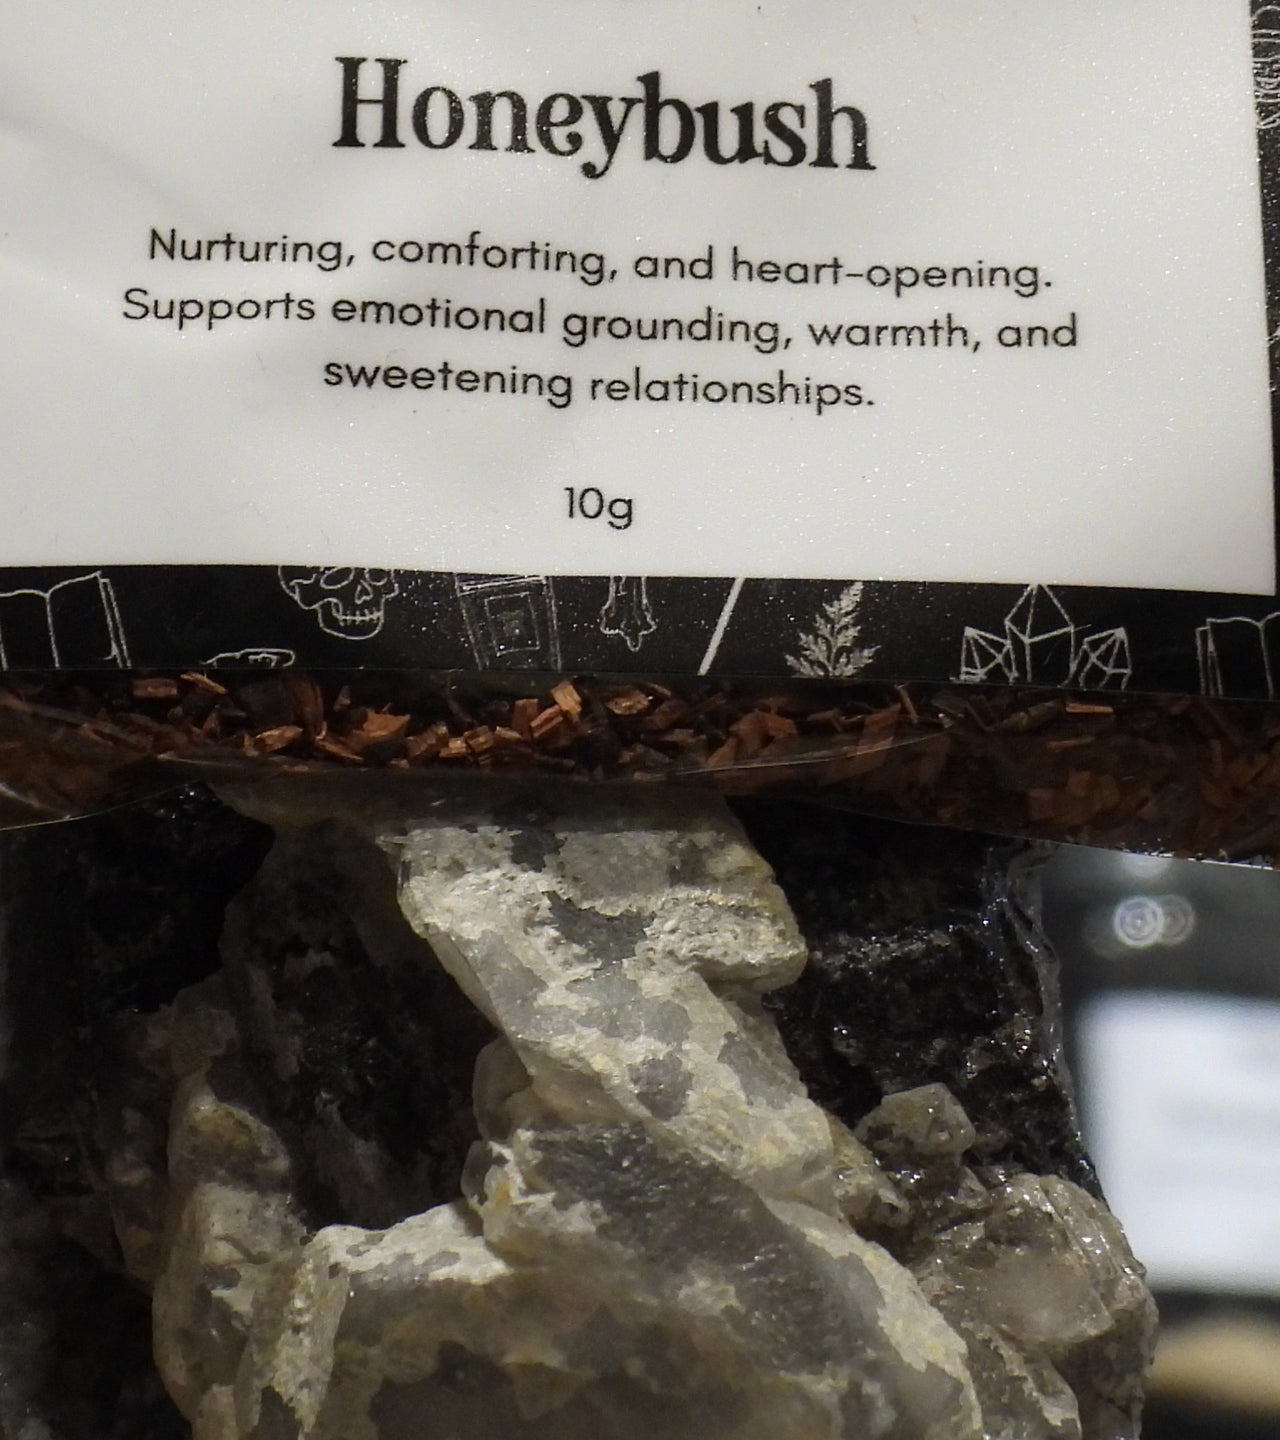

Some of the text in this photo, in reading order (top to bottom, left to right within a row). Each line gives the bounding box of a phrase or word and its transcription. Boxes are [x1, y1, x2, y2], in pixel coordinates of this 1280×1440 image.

[331, 56, 877, 180] Honeybush
[149, 228, 1052, 298] Nurturing, comforting, and heart-opening.
[123, 287, 1078, 354] Supports emotional grounding, warmth, and
[323, 361, 875, 416] sweetening relationships.
[564, 487, 633, 530] 10g
